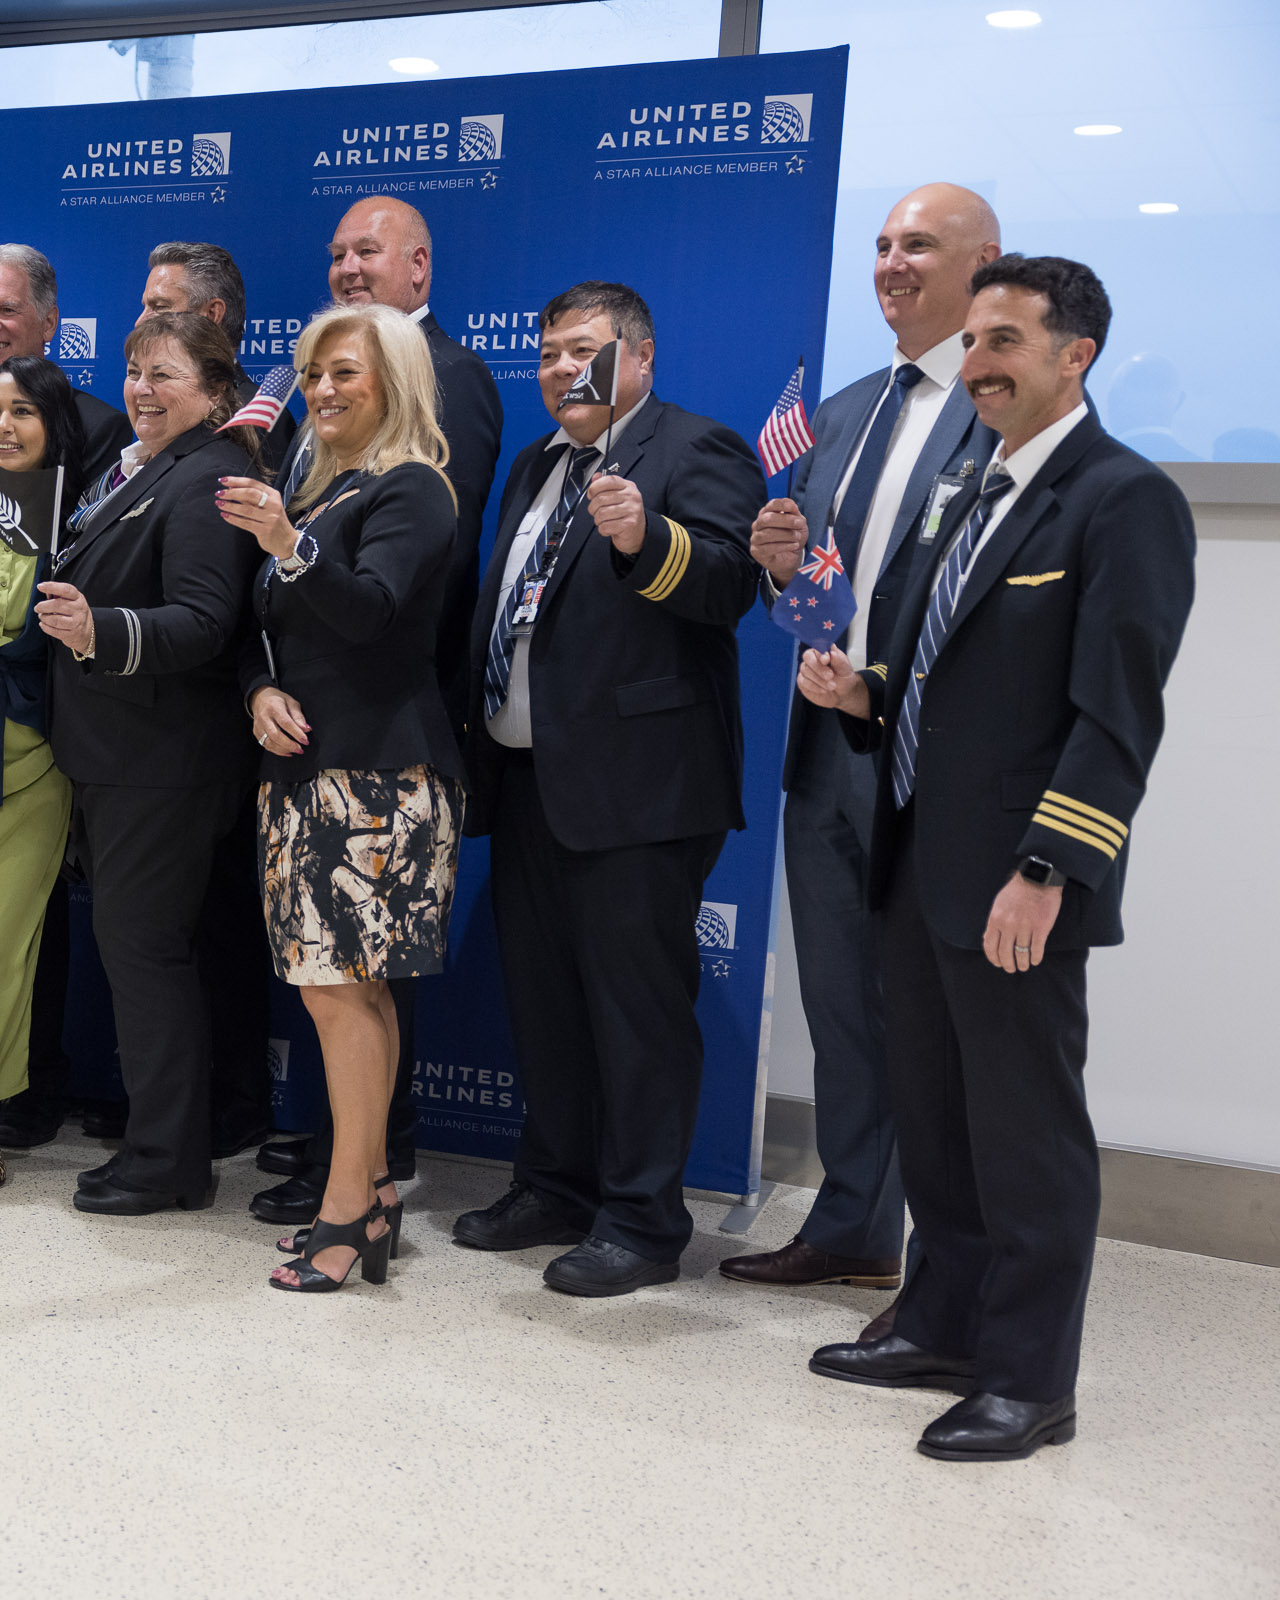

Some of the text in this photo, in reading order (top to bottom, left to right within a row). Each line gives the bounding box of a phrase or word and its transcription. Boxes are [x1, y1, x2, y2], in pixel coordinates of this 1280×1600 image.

[630, 101, 752, 125] UNITED
[342, 122, 450, 144] UNITED
[596, 124, 750, 150] AIRLINES
[87, 139, 183, 158] UNITED
[313, 143, 448, 167] AIRLINES
[61, 159, 183, 179] AIRLINES
[594, 161, 778, 181] A STAR ALLIANCE MEMBER
[311, 178, 474, 196] A STAR ALLIANCE MEMBER
[60, 192, 205, 207] A STAR ALLIANCE MEMBER
[244, 318, 302, 335] ITED
[468, 312, 539, 329] UNIT
[240, 339, 297, 355] INES
[461, 333, 540, 351] IRLIN
[491, 369, 539, 380] LLIANC
[412, 1061, 514, 1088] UNITED
[411, 1080, 512, 1108] RLINES
[418, 1115, 521, 1138] ALLIANCE MEMB
